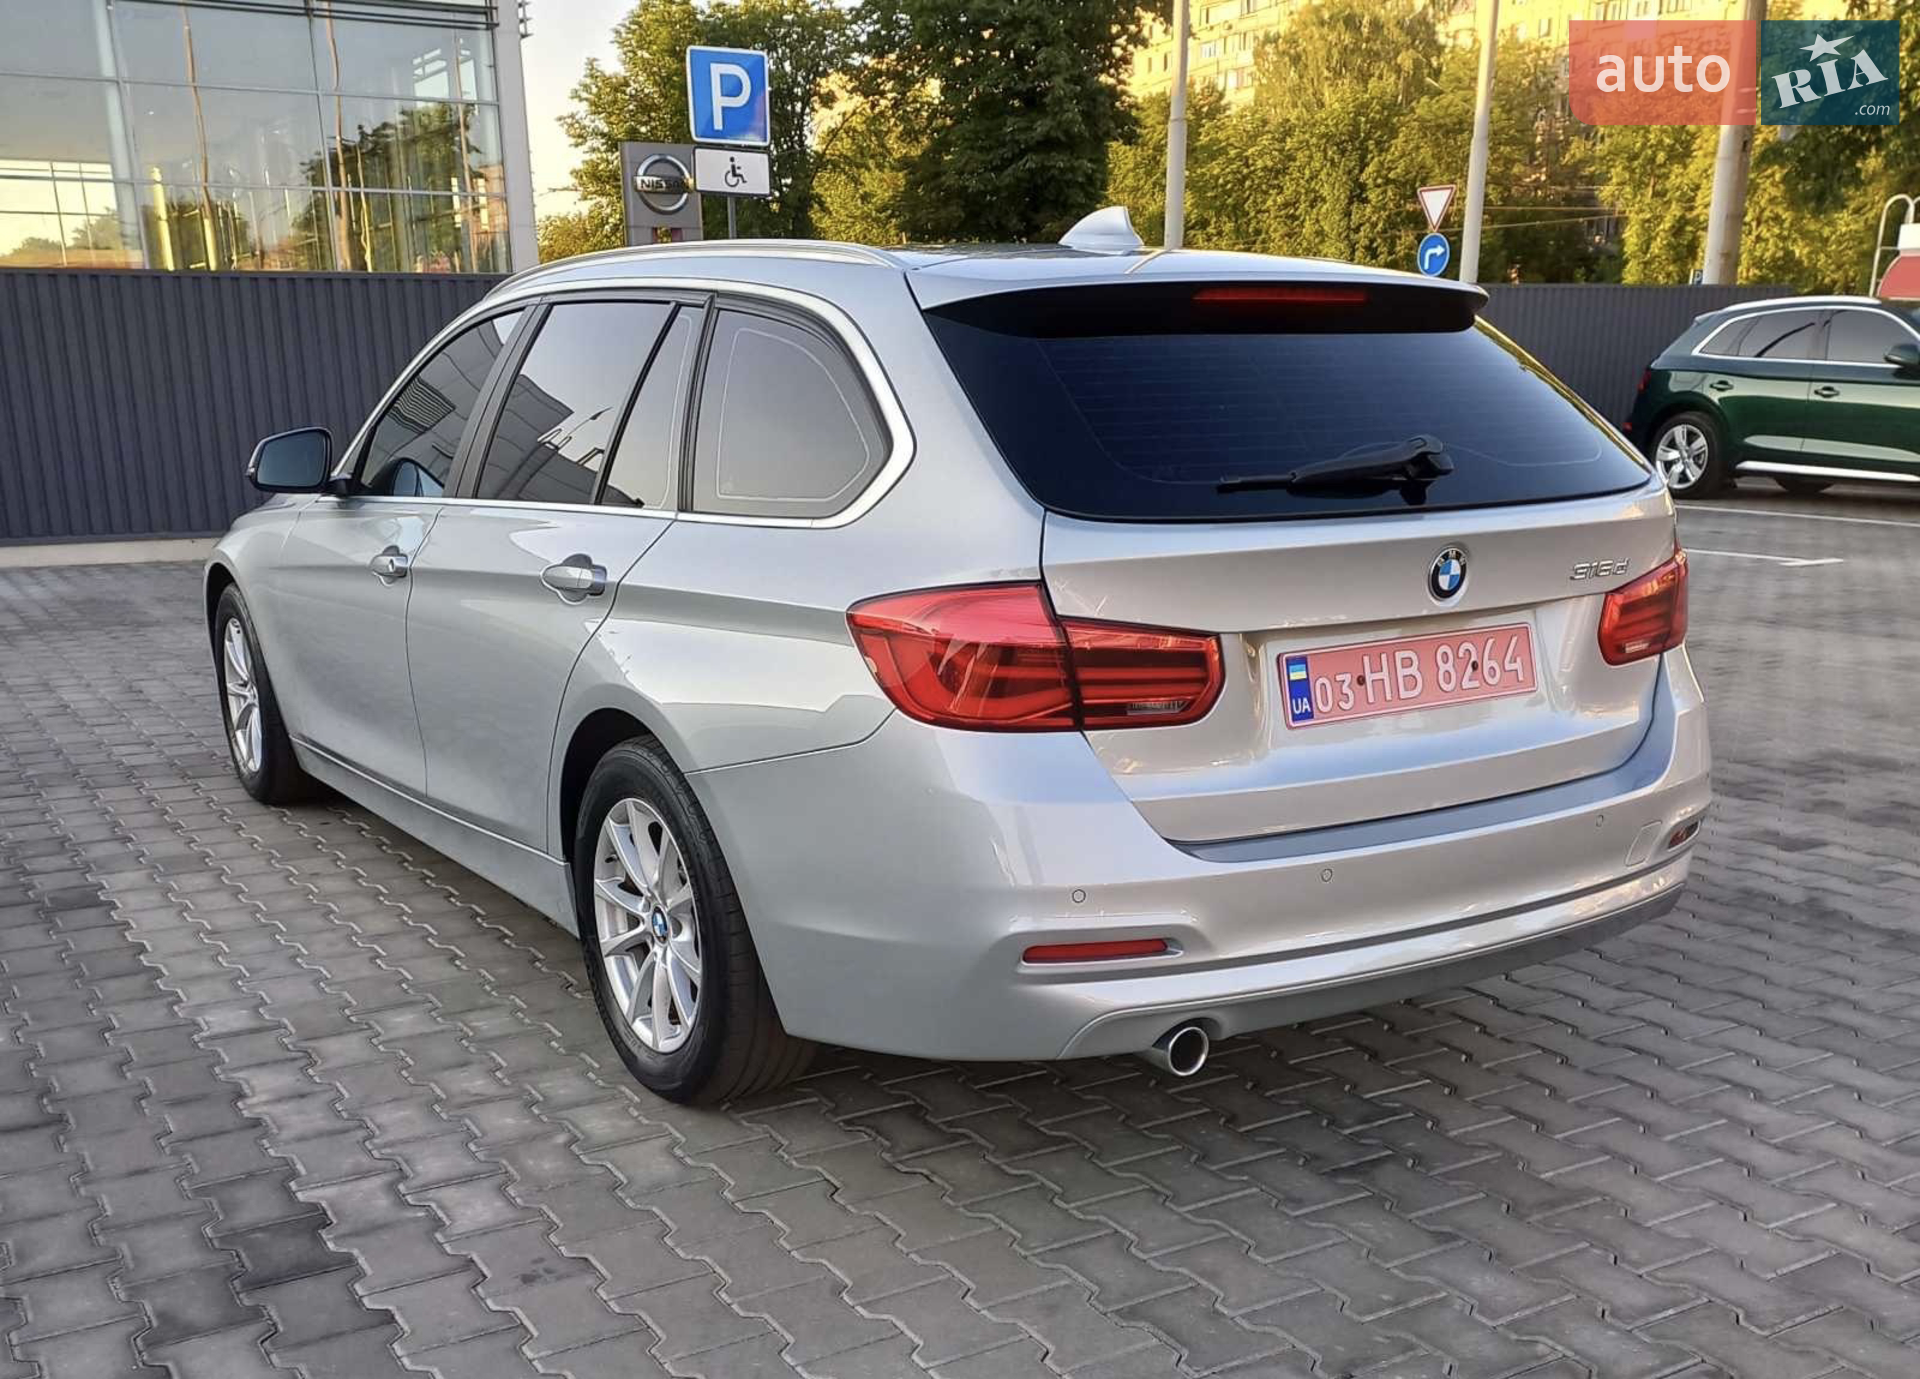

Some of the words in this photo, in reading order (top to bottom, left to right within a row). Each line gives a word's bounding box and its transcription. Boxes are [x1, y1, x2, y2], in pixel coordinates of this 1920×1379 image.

[709, 62, 752, 131] P
[1292, 696, 1312, 714] UA
[1314, 672, 1355, 713] 03
[1362, 650, 1423, 704] HB
[1436, 634, 1525, 693] 8264
